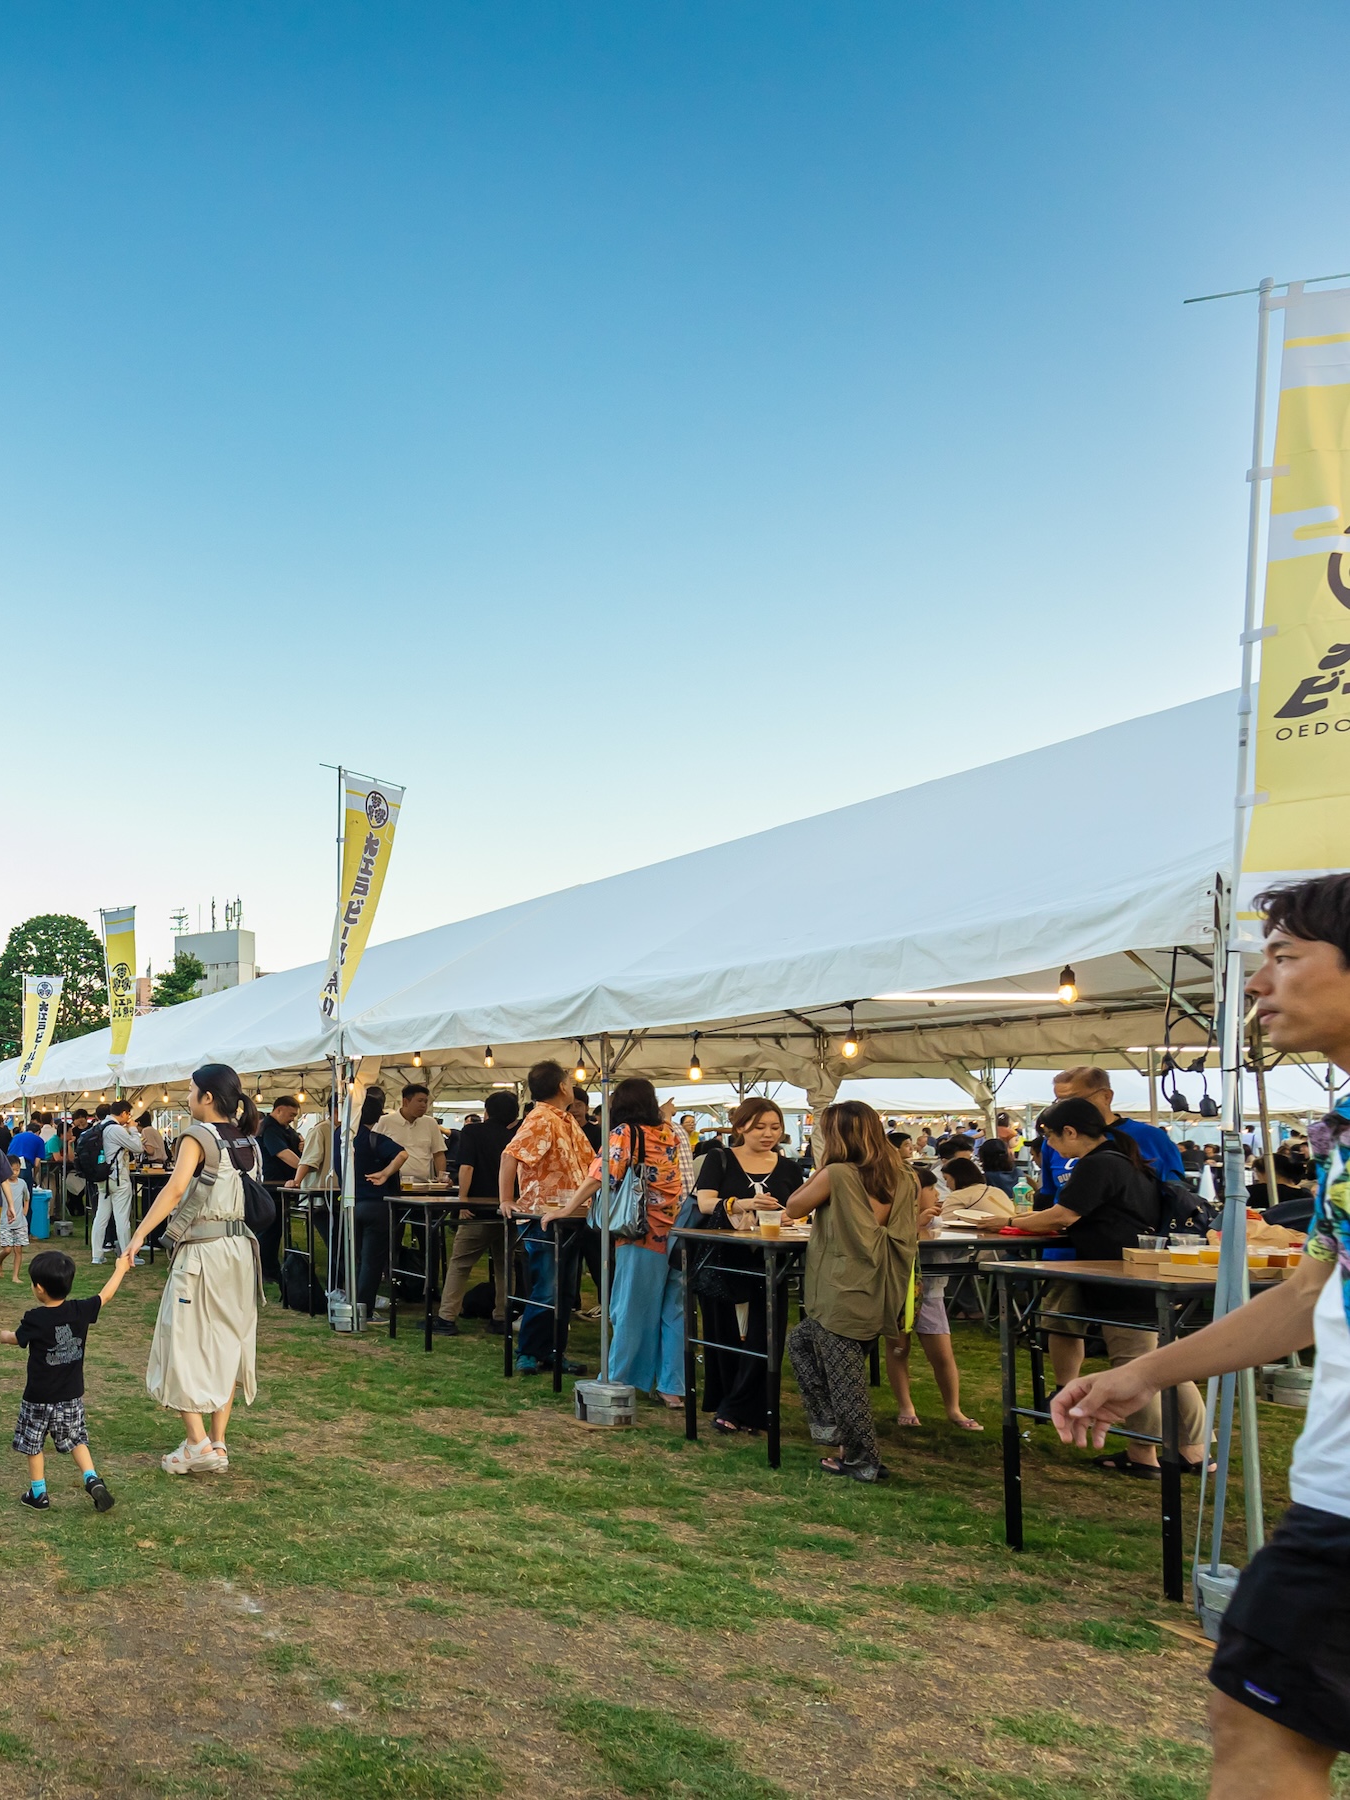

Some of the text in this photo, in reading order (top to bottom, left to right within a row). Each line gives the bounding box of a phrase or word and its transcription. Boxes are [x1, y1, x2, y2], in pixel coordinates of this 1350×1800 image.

[19, 1001, 49, 1085] 大江戸ビール祭り
